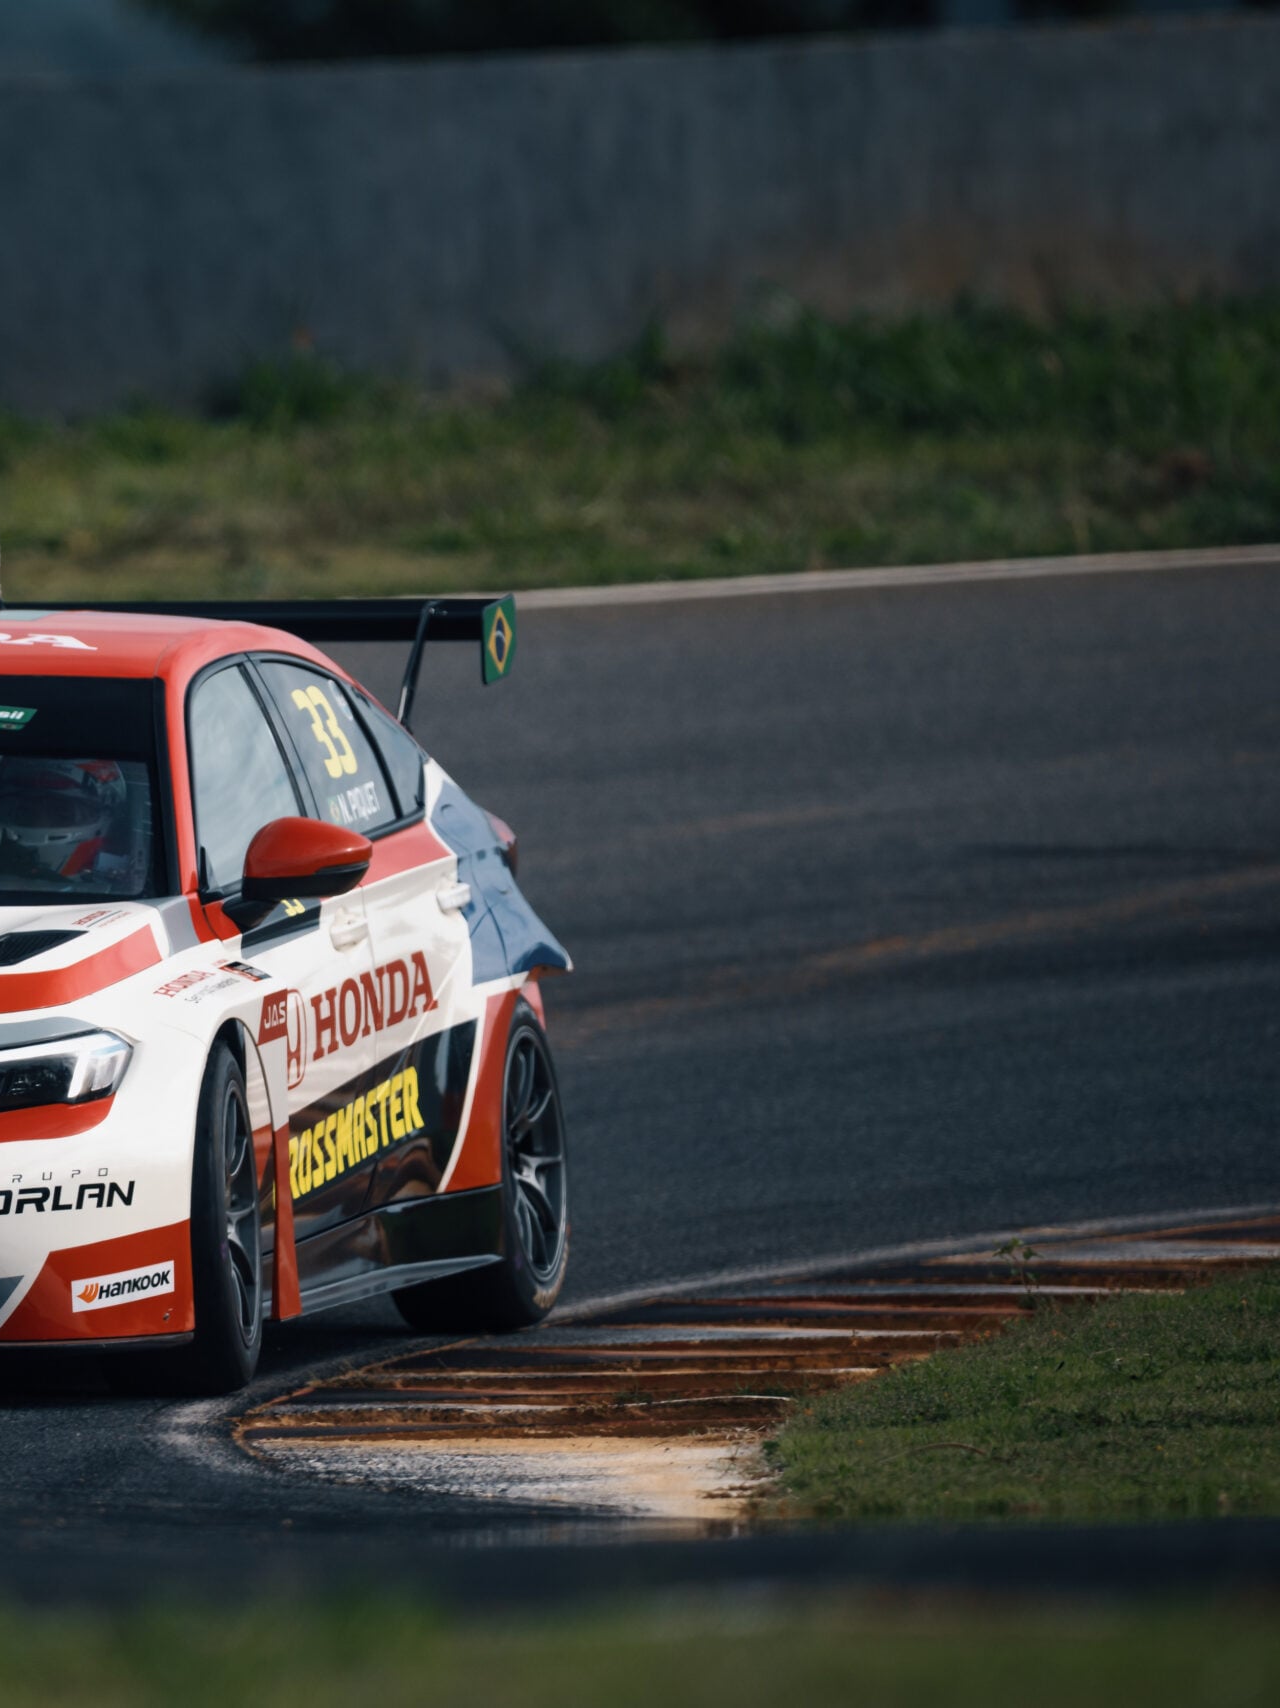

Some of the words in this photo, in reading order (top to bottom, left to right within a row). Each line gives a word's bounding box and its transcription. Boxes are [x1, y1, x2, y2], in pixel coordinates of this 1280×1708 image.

[291, 685, 357, 779] 33
[264, 1000, 286, 1030] JAS
[310, 950, 439, 1062] HONDA
[274, 1065, 425, 1209] ROSSMASTER
